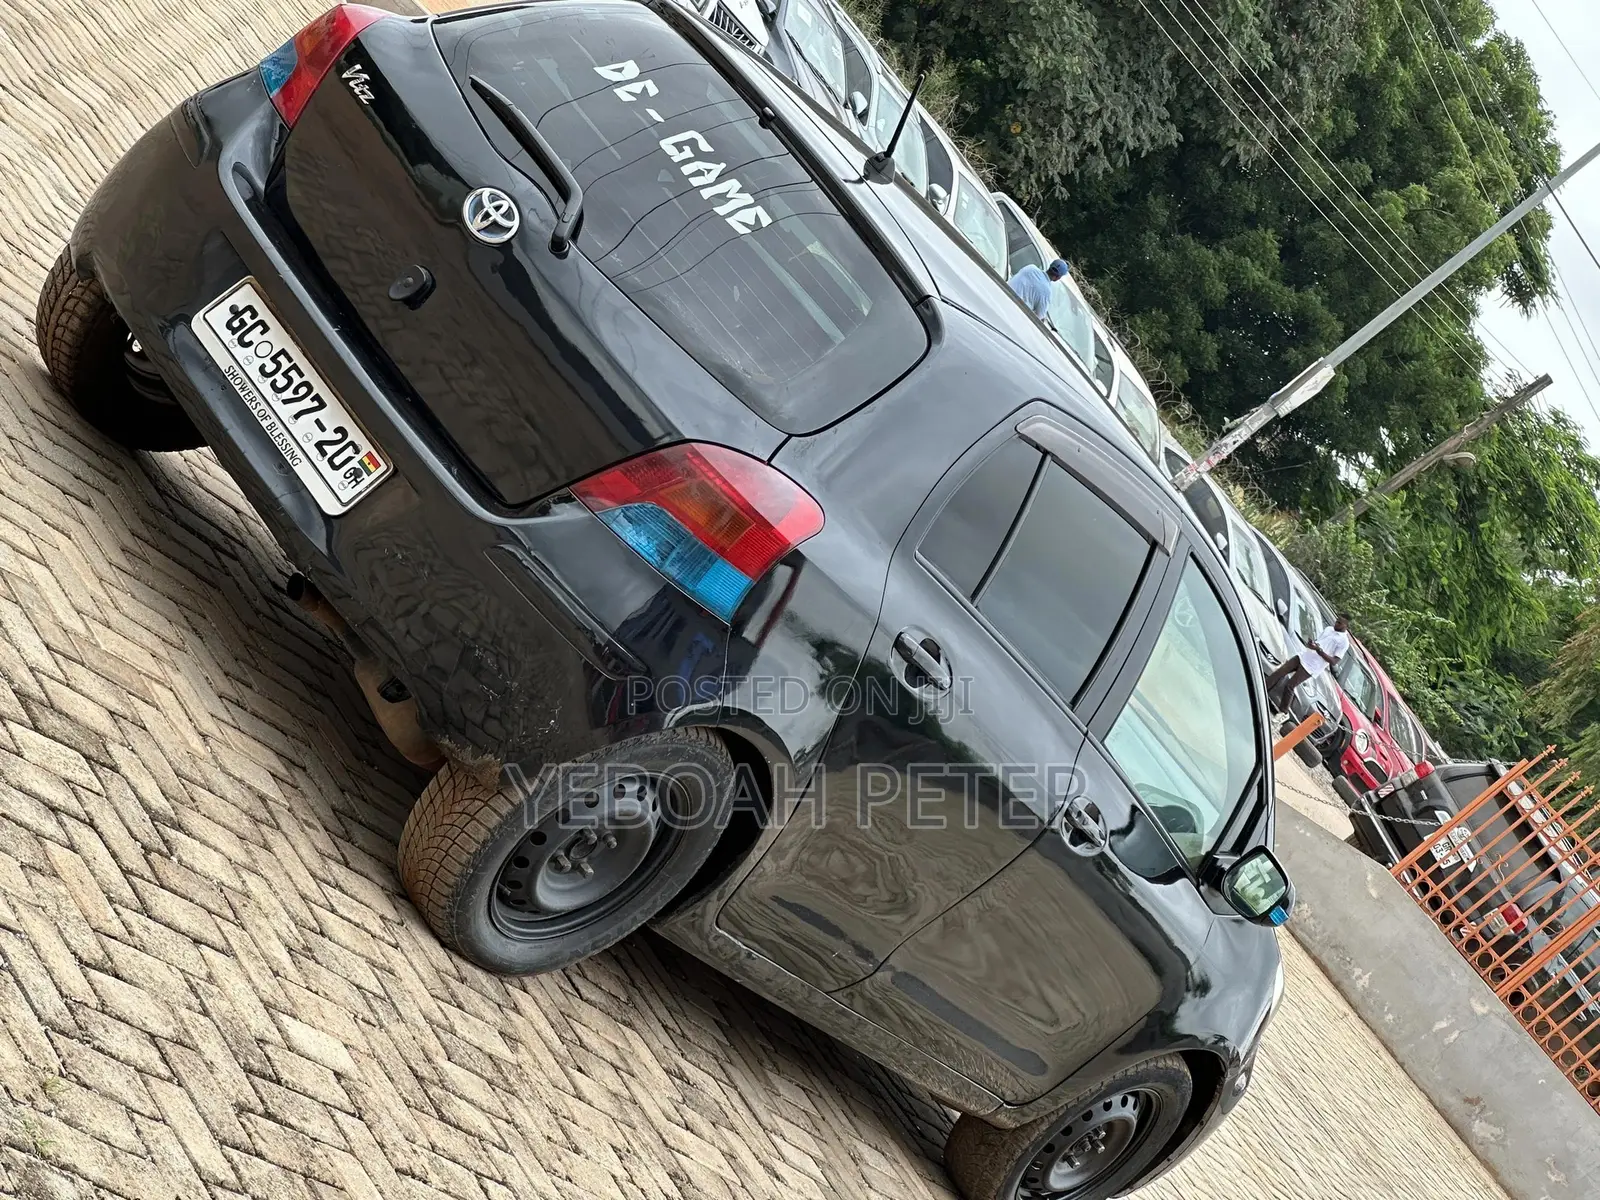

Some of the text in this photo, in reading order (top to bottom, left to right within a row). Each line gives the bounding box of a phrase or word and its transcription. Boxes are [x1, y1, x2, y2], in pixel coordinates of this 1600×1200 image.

[341, 64, 375, 105] Vitz
[659, 130, 773, 235] GAME
[224, 365, 302, 467] SHOWERS OF BLESSING
